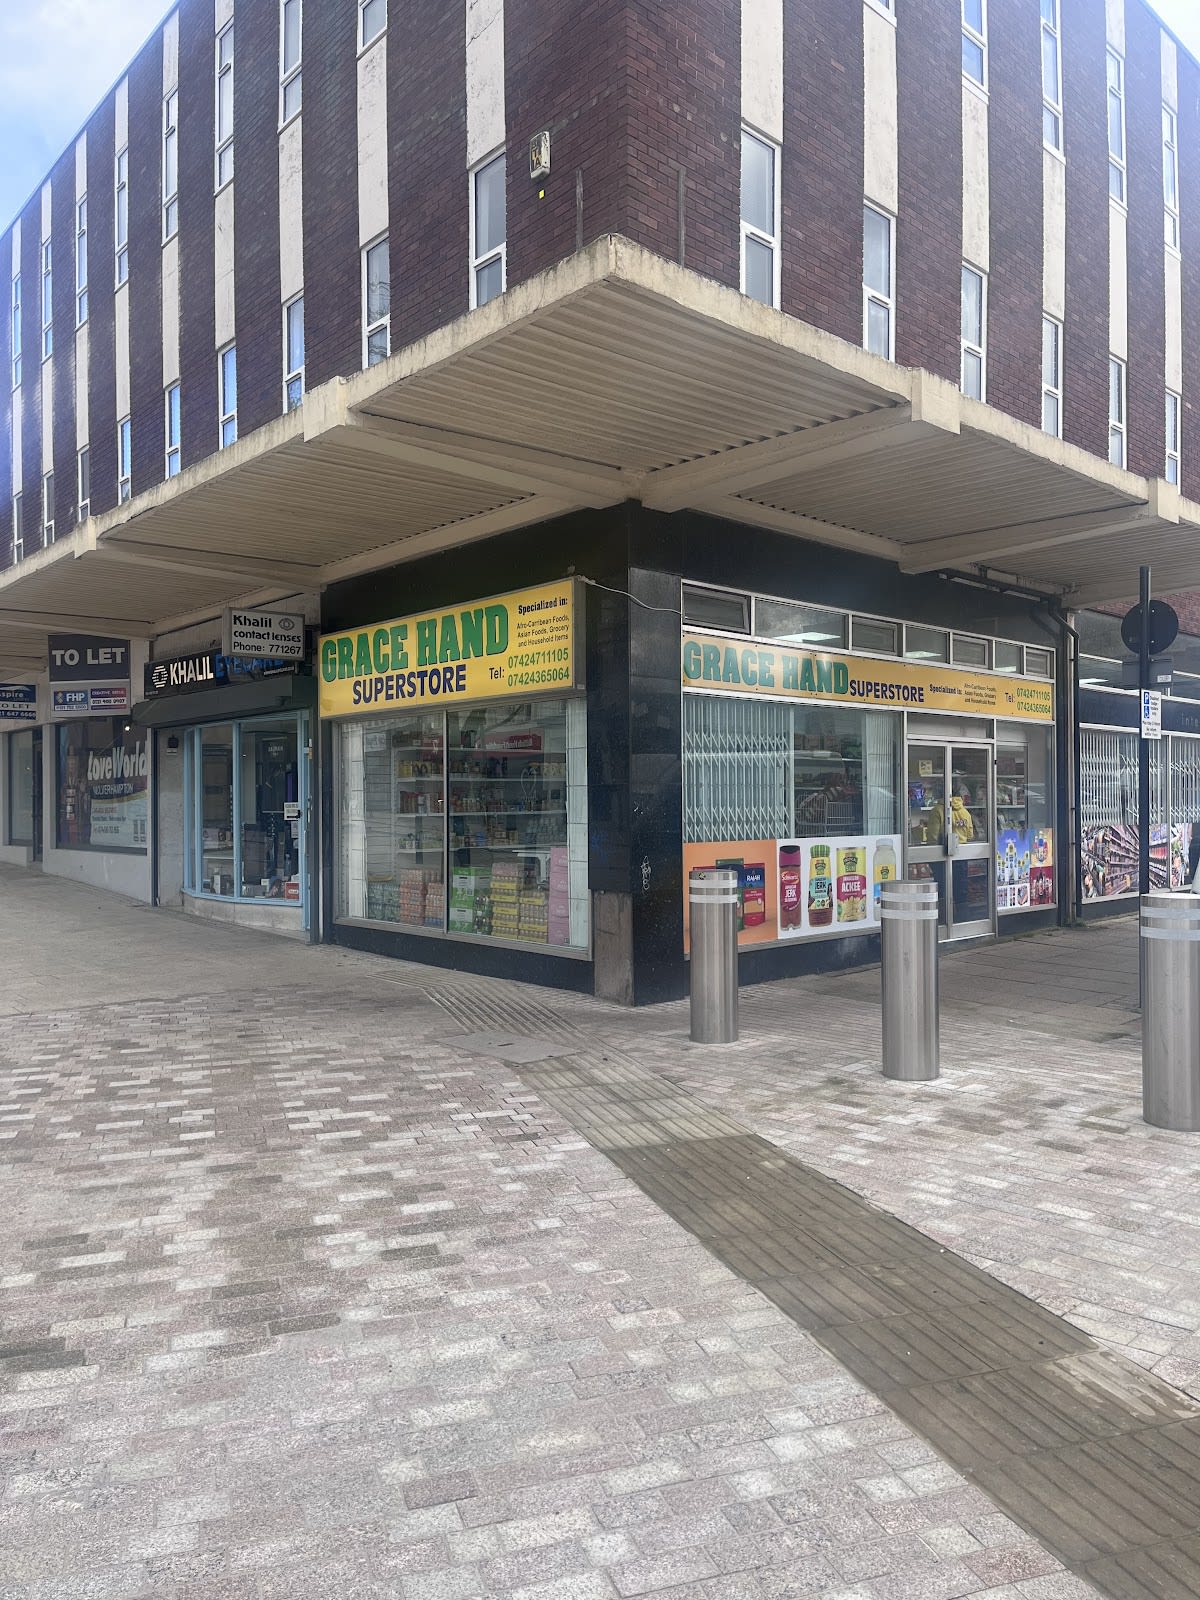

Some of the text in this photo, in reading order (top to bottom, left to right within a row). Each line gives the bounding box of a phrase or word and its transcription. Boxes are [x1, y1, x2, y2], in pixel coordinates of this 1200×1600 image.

[518, 597, 568, 615] Specialized in:
[233, 614, 272, 628] Khalil
[233, 629, 302, 643] contact lenses
[549, 624, 569, 634] Grocery
[233, 641, 301, 655] Phone: 771267
[321, 604, 509, 683] GRACE HAND
[527, 636, 554, 646] Household
[51, 647, 126, 666] TO LET
[508, 648, 569, 669] 07424711105
[169, 655, 214, 686] KHALIL
[489, 667, 505, 680] Tel:
[683, 640, 848, 695] GRACE HAND
[353, 664, 466, 704] SUPERSTORE
[508, 667, 569, 687] 07424365064
[66, 692, 85, 702] FHP
[849, 679, 925, 703] SUPERSTORE
[1005, 692, 1016, 703] Tel:
[1016, 687, 1051, 701] 07424711105
[1016, 701, 1051, 714] 07424365064
[87, 741, 148, 781] LoveWorld
[93, 784, 134, 795] WOLVERHAMPTON
[841, 881, 861, 893] ACKEE
